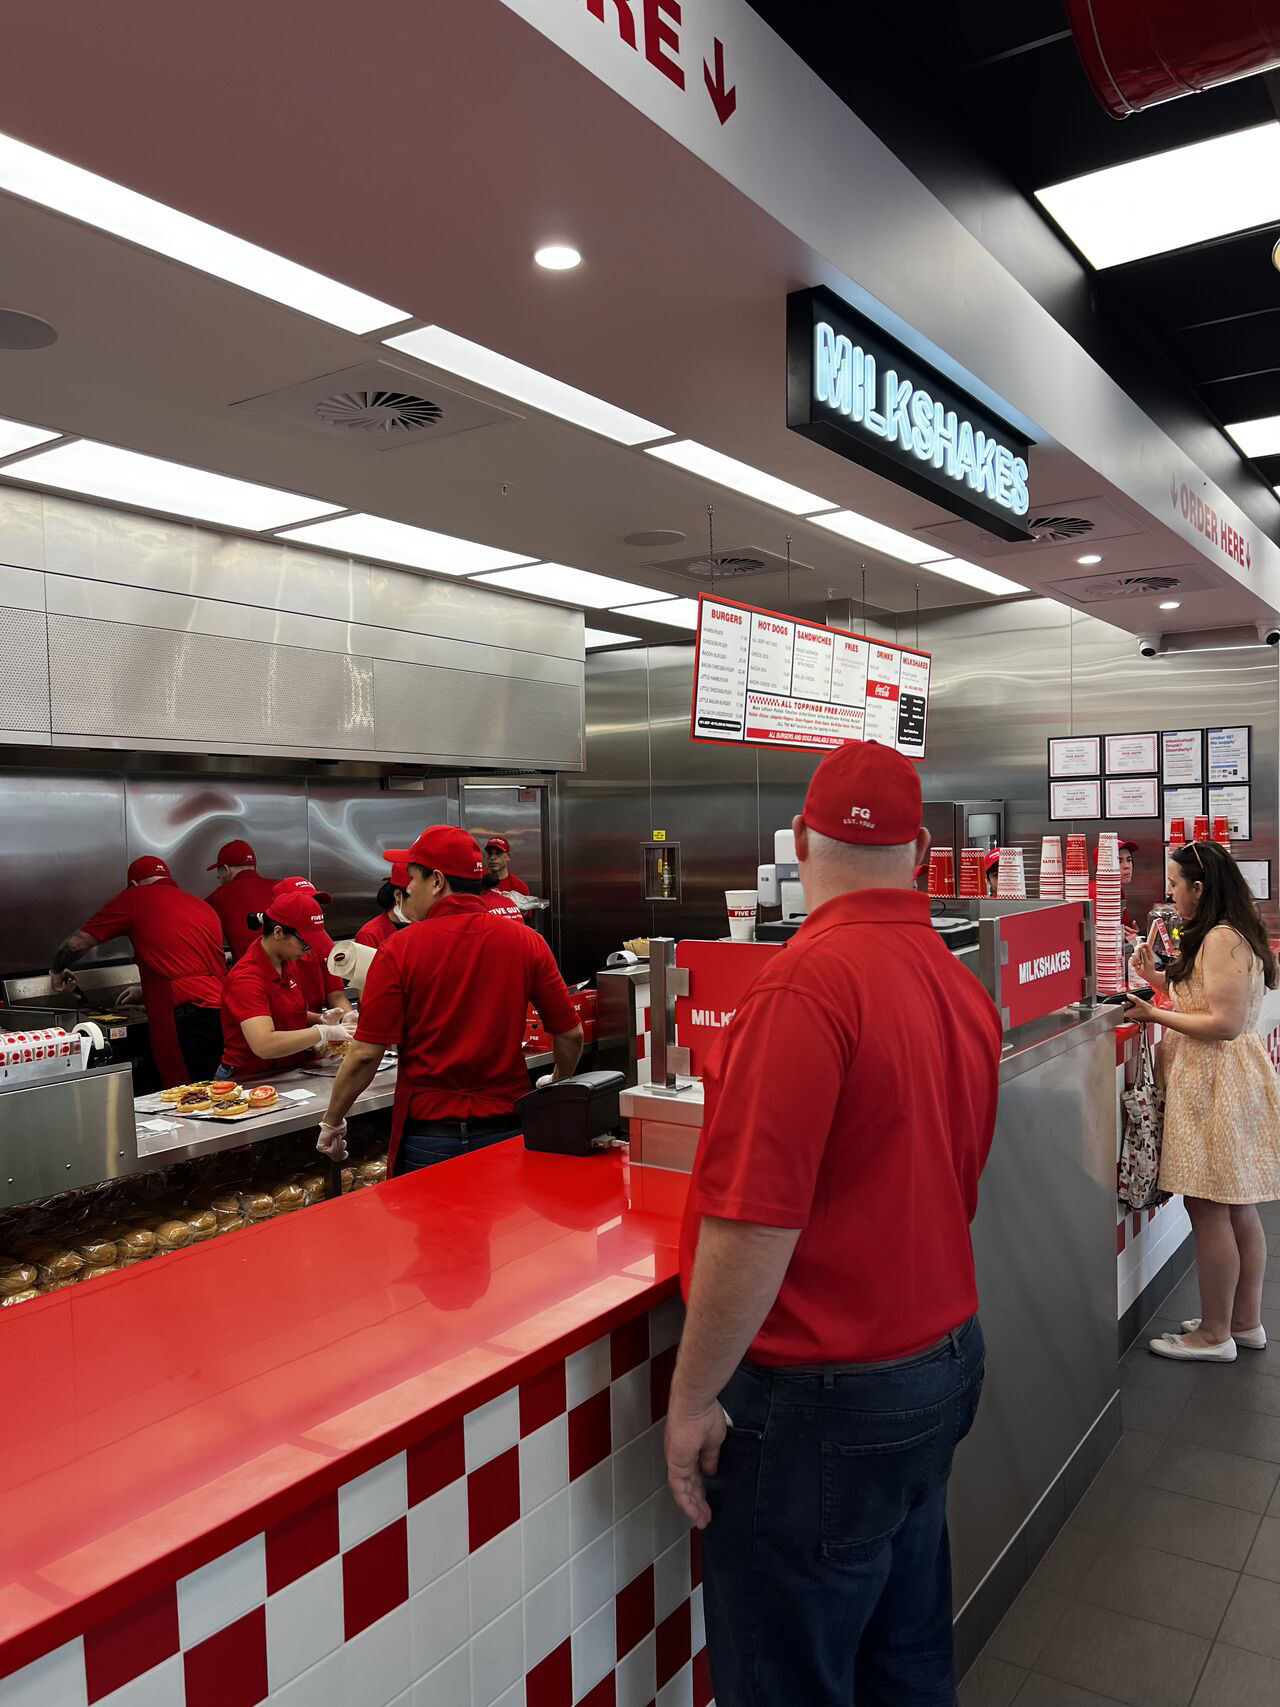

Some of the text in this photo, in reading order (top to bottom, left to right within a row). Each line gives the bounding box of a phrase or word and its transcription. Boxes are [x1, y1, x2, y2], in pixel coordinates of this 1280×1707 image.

[816, 321, 1029, 516] MILKSHAKES
[1181, 482, 1244, 567] ORDER HERE
[712, 609, 742, 625] BURGERS
[758, 621, 788, 636] HOT DOGS
[797, 630, 831, 646] SANDWICHES
[845, 642, 858, 653] FRIES
[877, 650, 893, 662] DRINKS
[903, 657, 928, 669] MILKSHAKES
[781, 700, 838, 715] ALL TOPPINGS FREE
[776, 732, 794, 740] BURGERS
[851, 806, 870, 819] FG
[506, 906, 521, 914] GUY
[1019, 949, 1071, 985] MILKSHAKES
